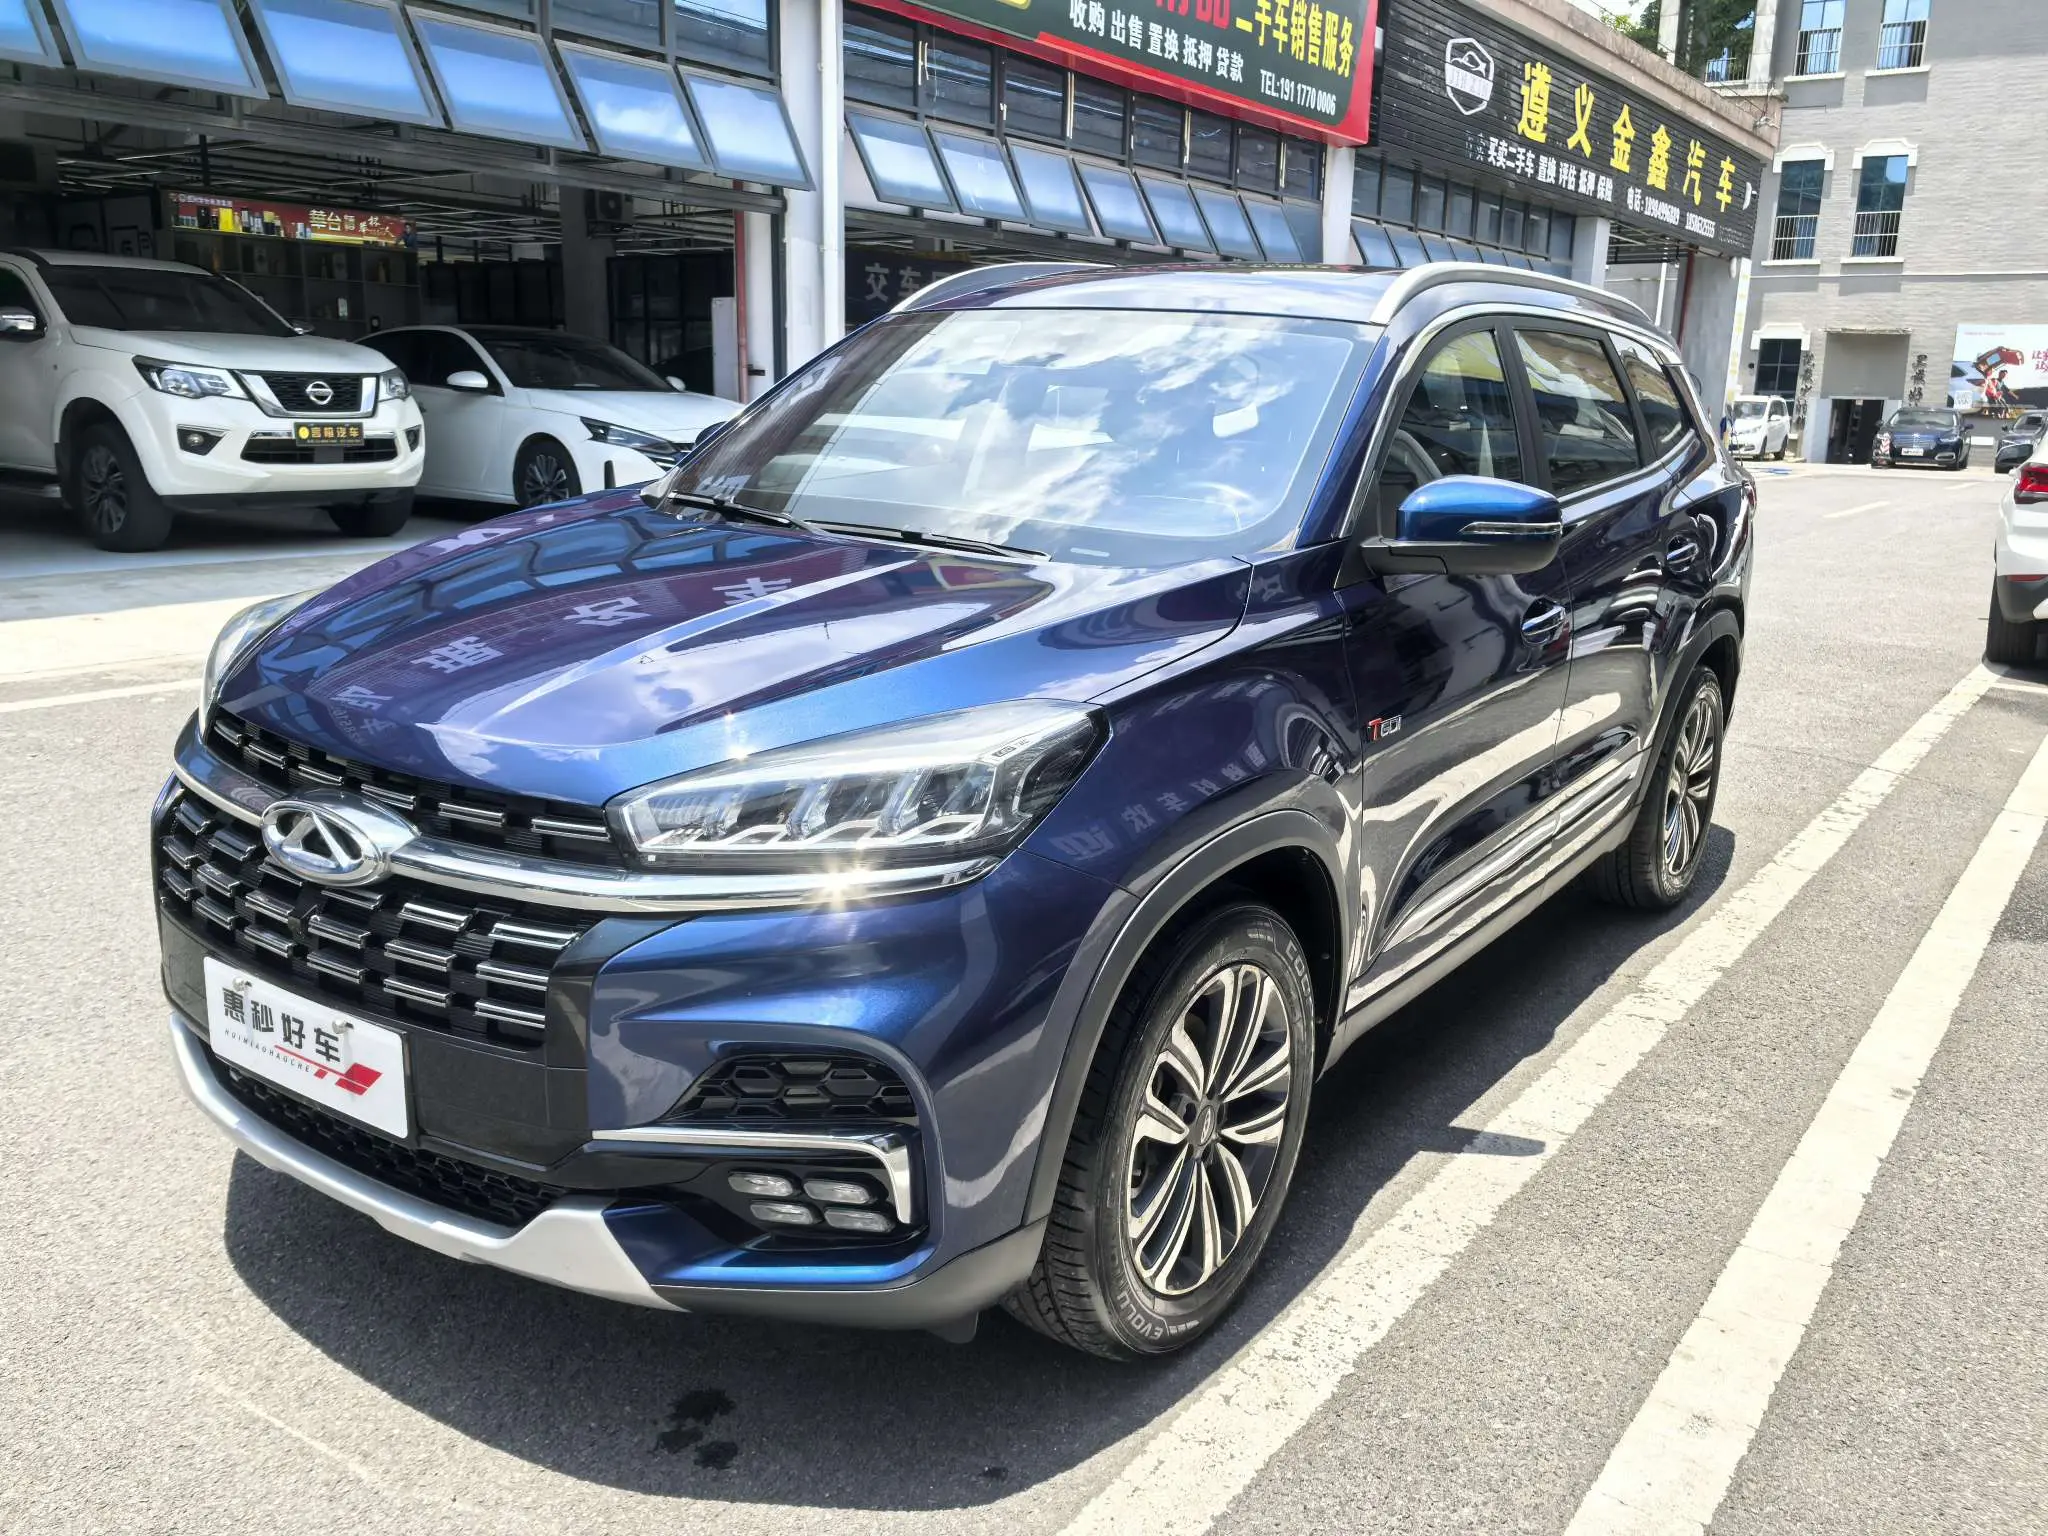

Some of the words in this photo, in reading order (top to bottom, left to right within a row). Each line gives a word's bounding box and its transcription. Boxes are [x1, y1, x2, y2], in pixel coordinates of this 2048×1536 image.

[1069, 0, 1105, 37] 收购
[1110, 9, 1143, 50] 出售
[1147, 22, 1180, 62] 置换
[1182, 34, 1213, 73] 抵押
[1216, 46, 1244, 83] 贷款
[1296, 83, 1316, 109] 1770
[1316, 90, 1337, 116] 0006
[1487, 136, 1536, 178] 买卖二手车
[1537, 154, 1557, 185] 置换
[1517, 62, 1737, 213] 遵义金鑫汽车
[222, 987, 341, 1064] 惠秒好车
[224, 1028, 311, 1073] HUIMIAOHAOCHE
